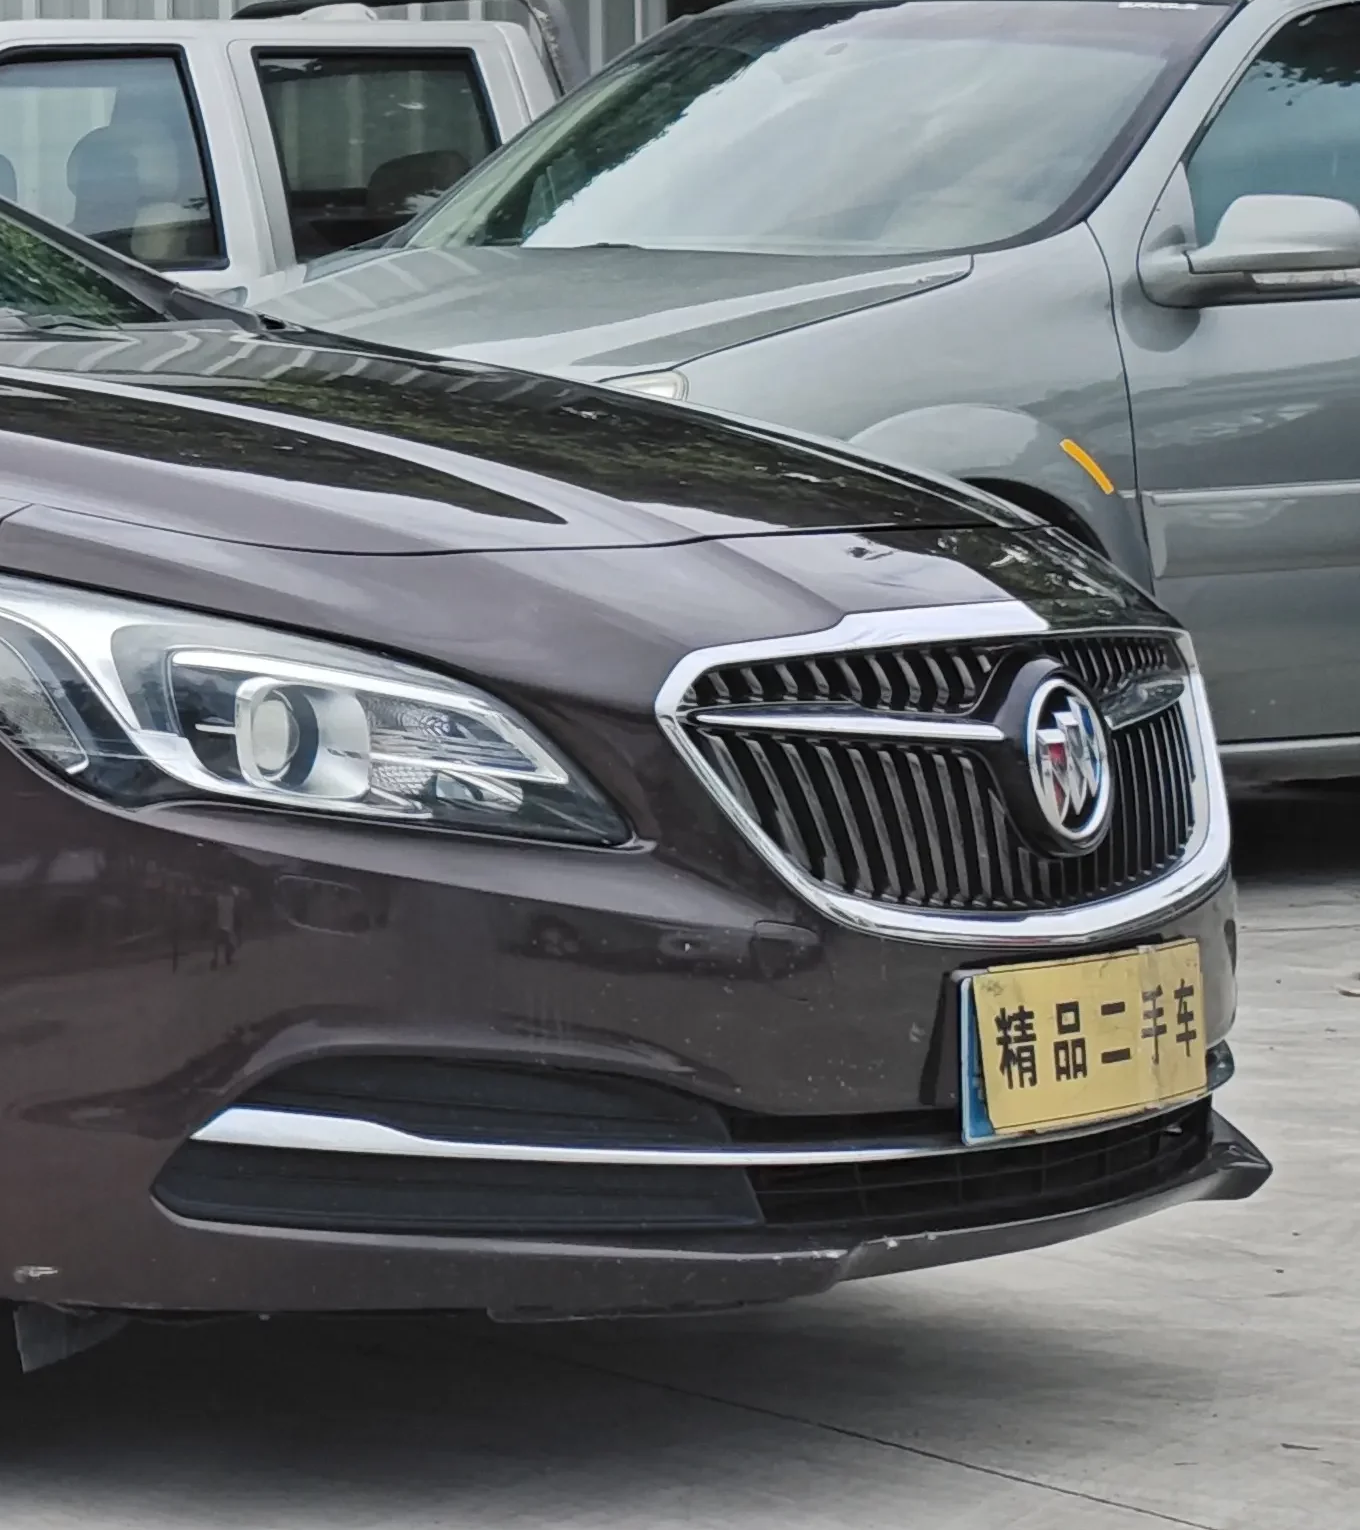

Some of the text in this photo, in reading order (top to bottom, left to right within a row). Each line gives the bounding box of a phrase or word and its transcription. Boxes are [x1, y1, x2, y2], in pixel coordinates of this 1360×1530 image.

[994, 979, 1198, 1089] 精品二手车
